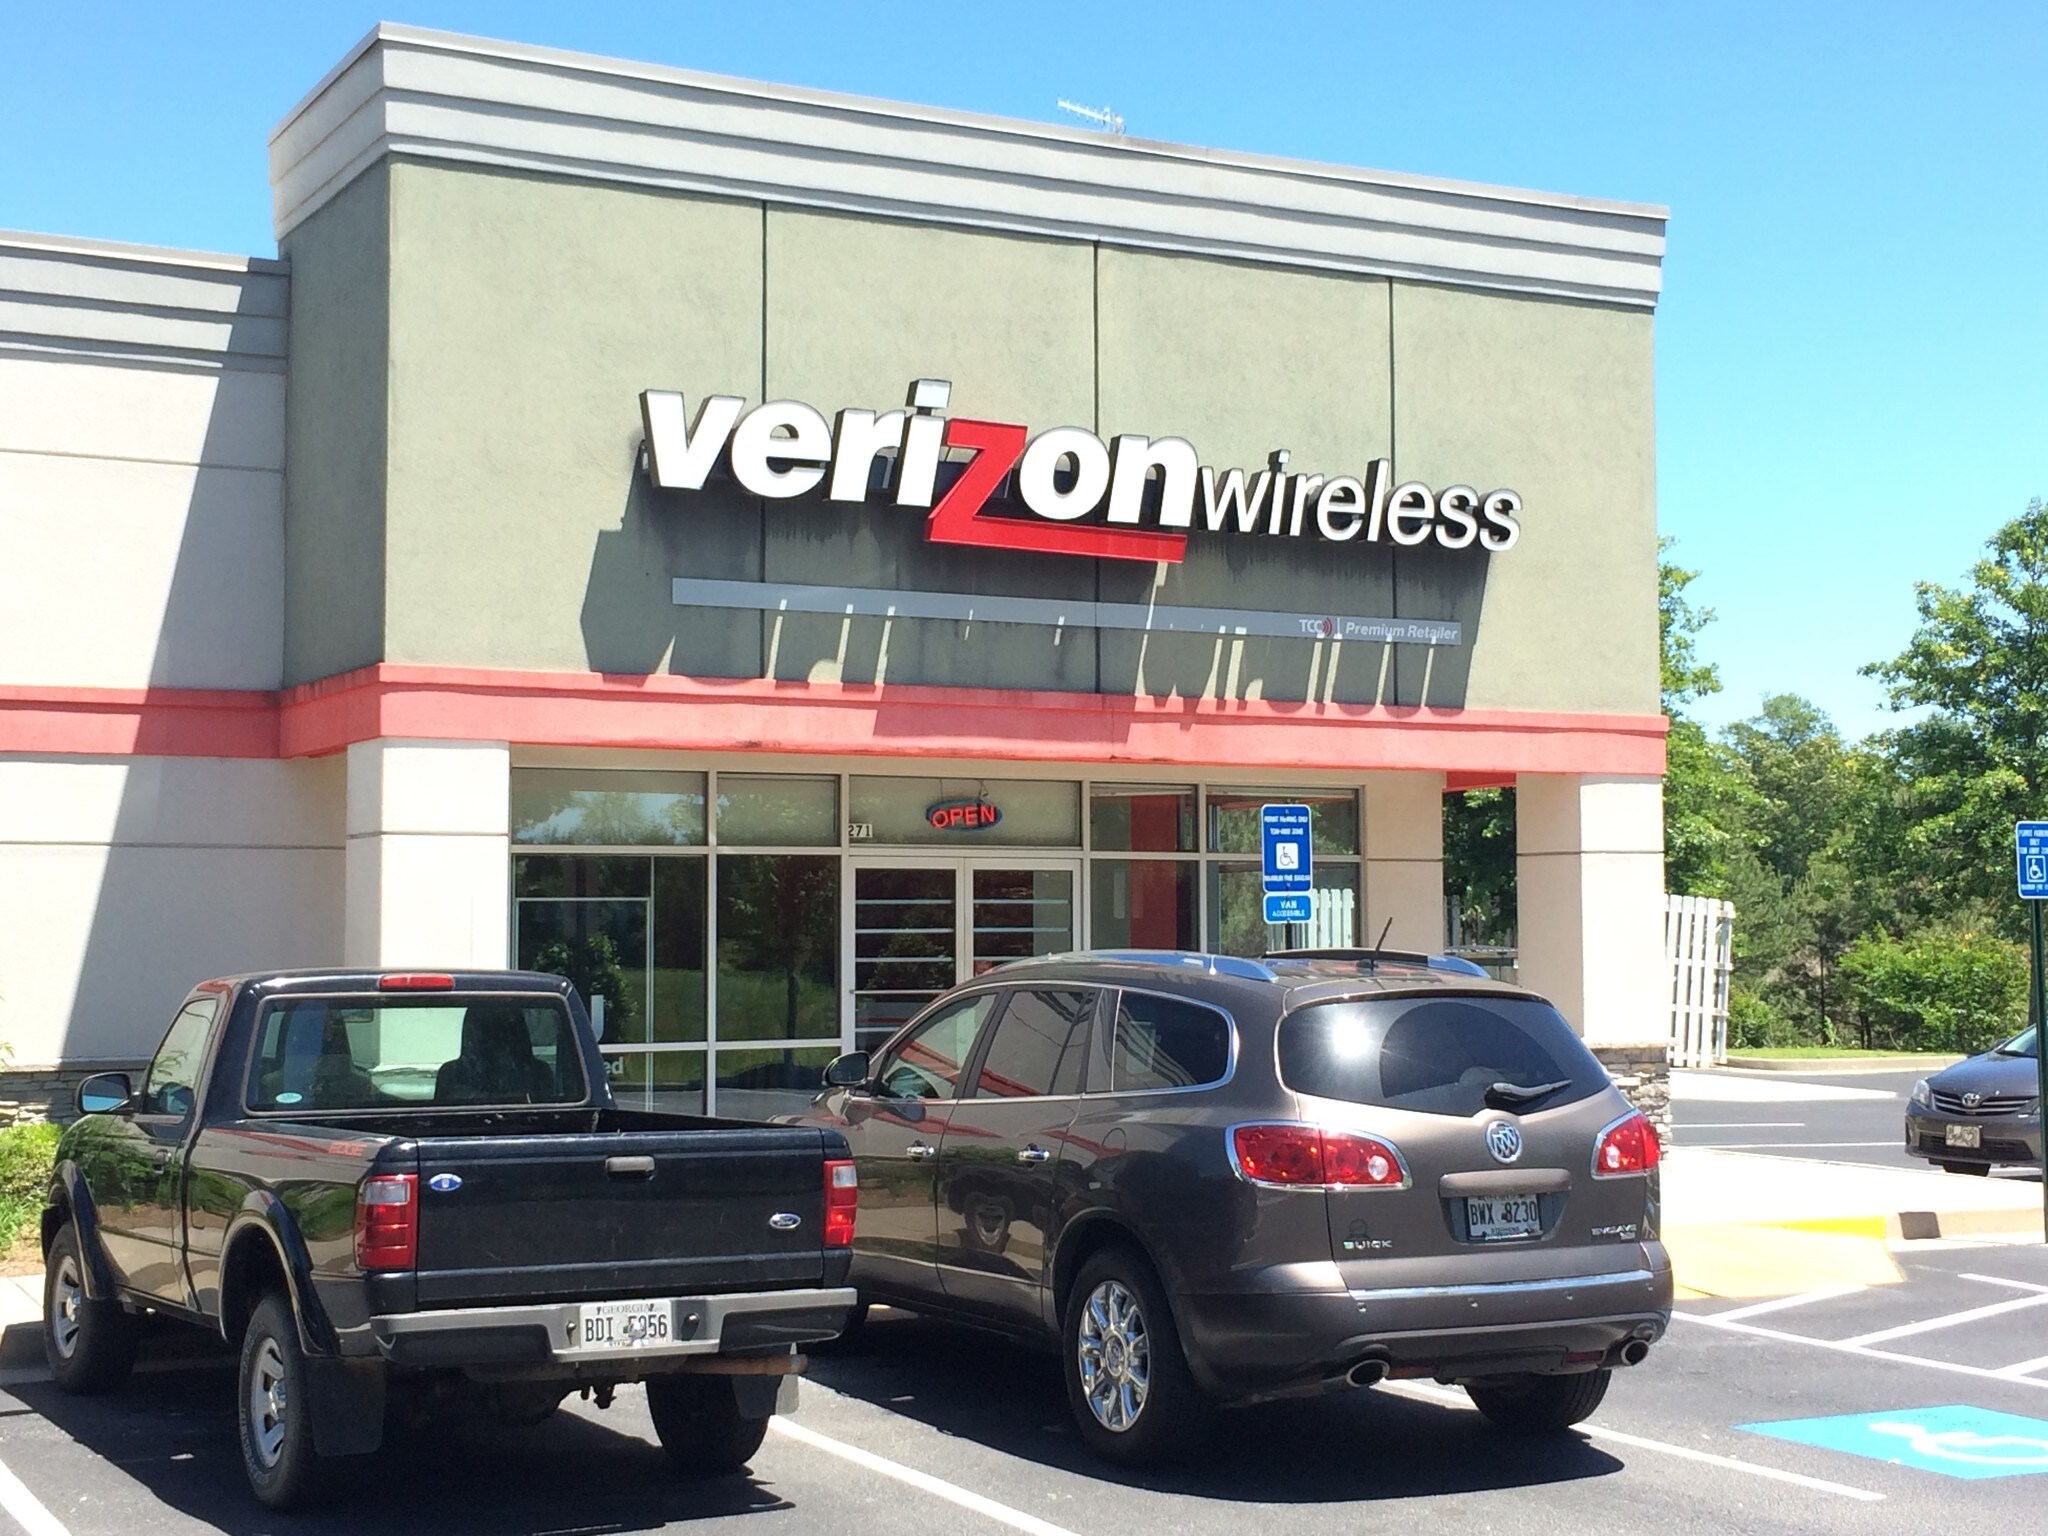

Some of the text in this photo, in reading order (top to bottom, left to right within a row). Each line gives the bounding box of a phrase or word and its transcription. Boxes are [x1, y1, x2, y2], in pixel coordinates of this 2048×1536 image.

[640, 378, 1522, 563] verizon wireless
[1299, 619, 1458, 640] TCC Premium Retailer
[930, 804, 996, 829] OPEN
[848, 824, 871, 837] 271
[1280, 900, 1298, 909] VAN
[1470, 1201, 1538, 1226] BWX 8230
[1343, 1240, 1392, 1249] BUICK
[585, 1317, 614, 1342] BDI
